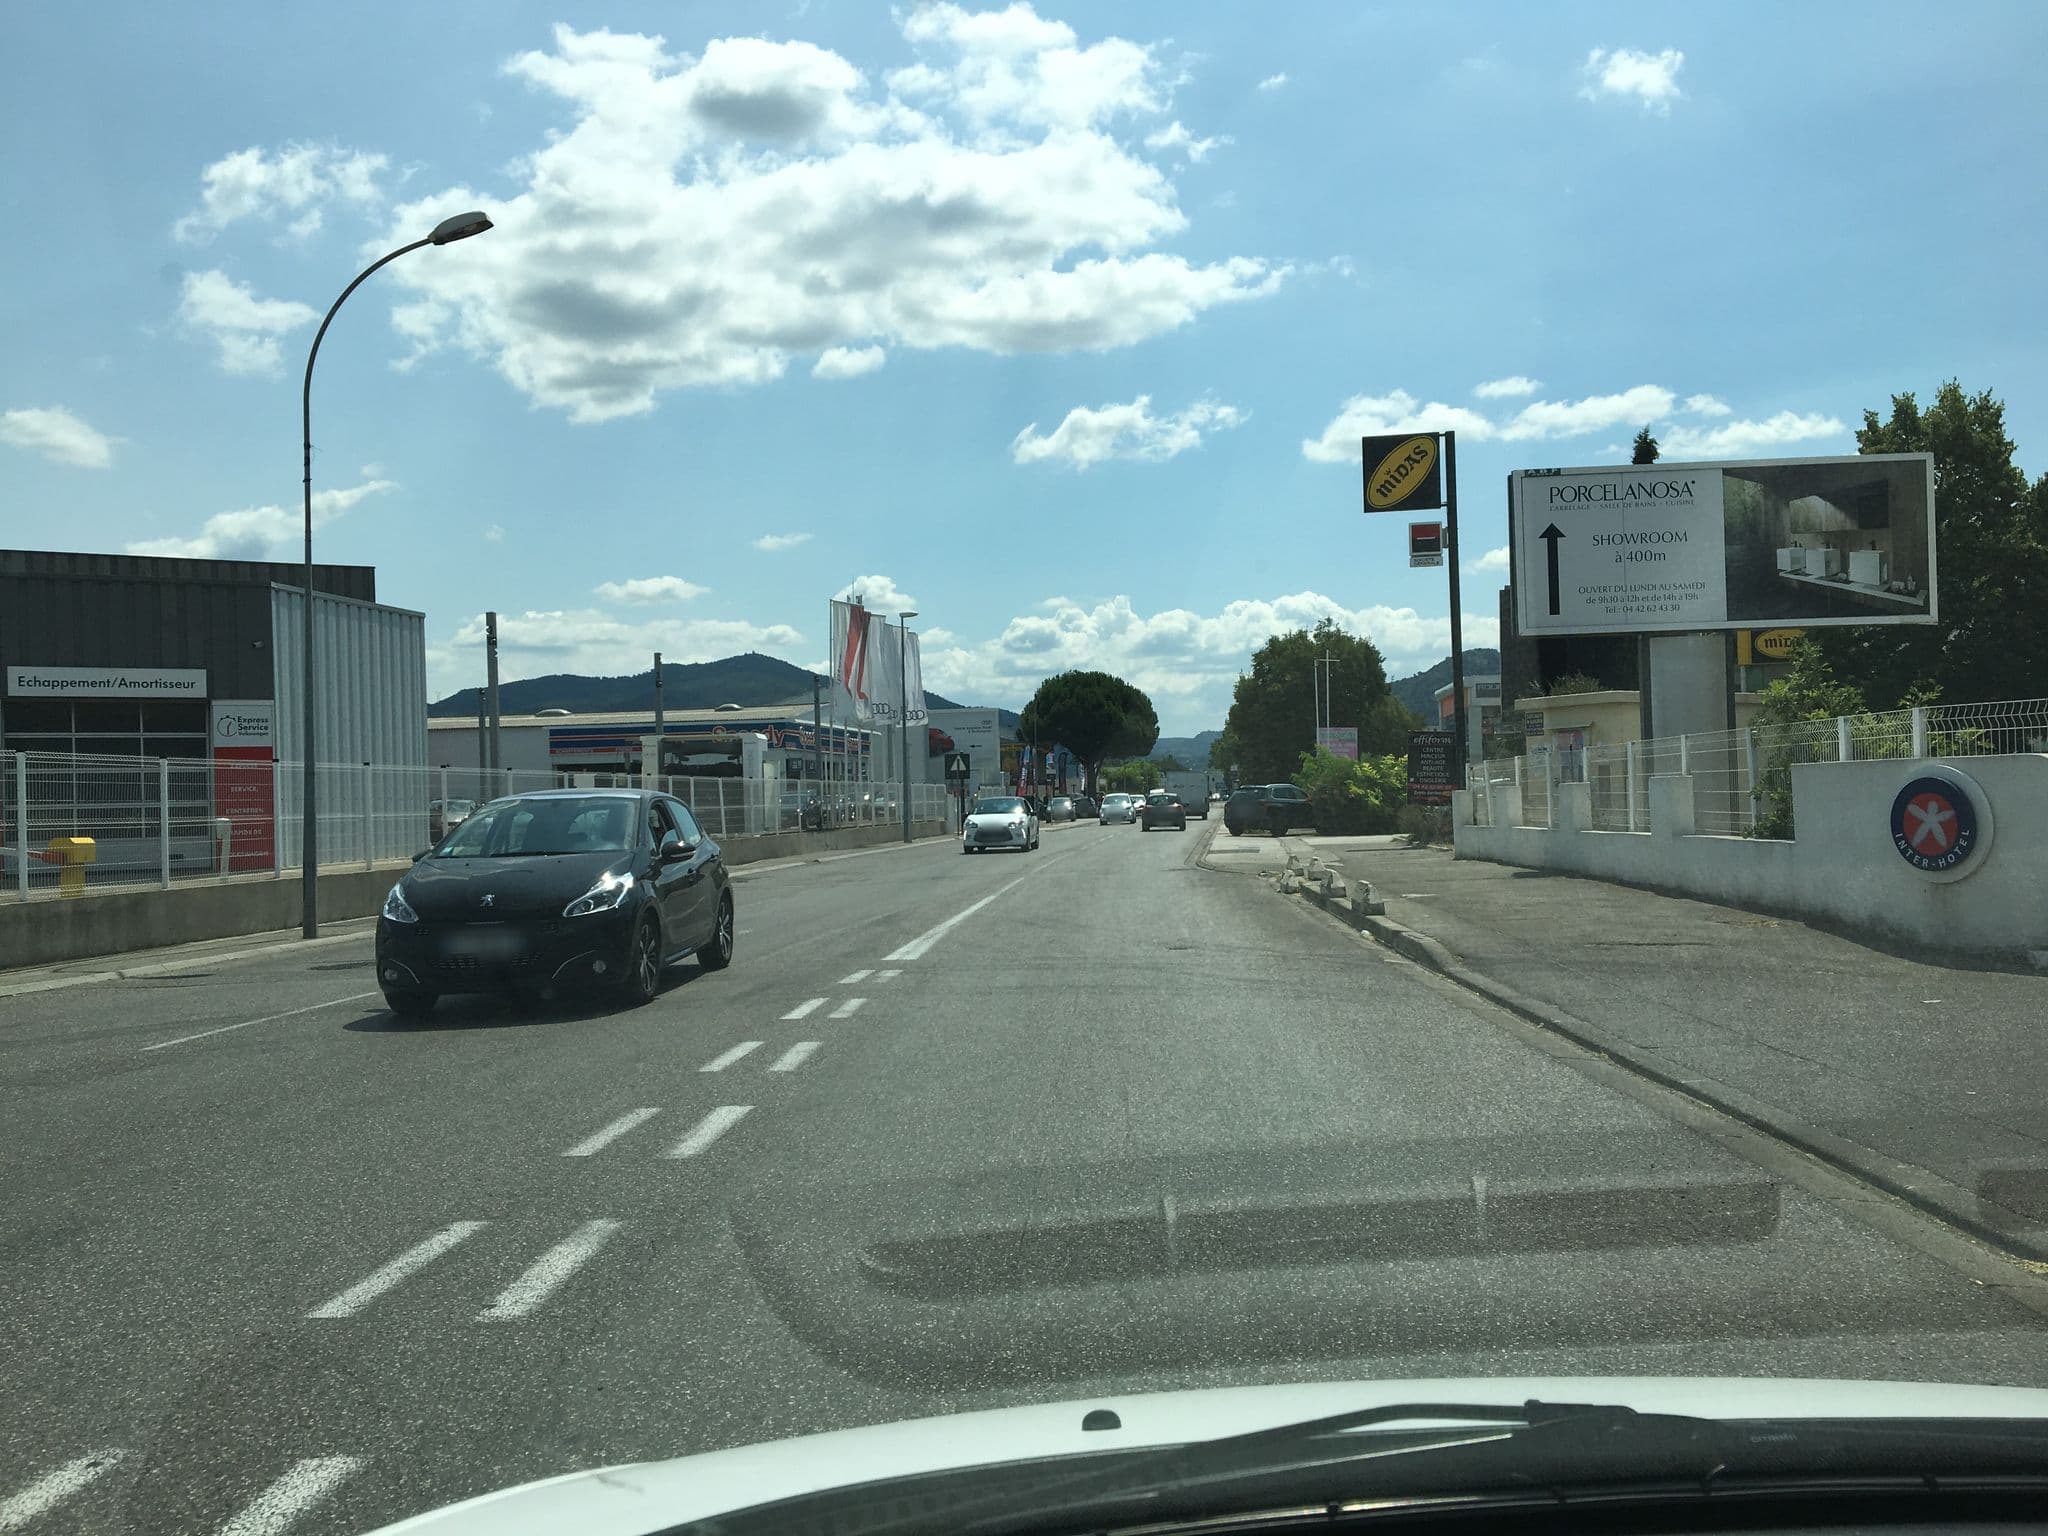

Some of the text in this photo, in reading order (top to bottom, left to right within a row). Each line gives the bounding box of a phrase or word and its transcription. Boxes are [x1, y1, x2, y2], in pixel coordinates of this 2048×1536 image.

[1549, 481, 1693, 503] PORCELANOSA
[1592, 531, 1688, 546] SHOWROOM
[1615, 550, 1666, 563] à 400m
[1578, 582, 1706, 594] OUVERT DU LUNDI AU SAMEDI
[1585, 596, 1597, 605] de
[1598, 595, 1619, 604] 9h30
[1626, 594, 1640, 603] 12h
[1641, 594, 1649, 602] et
[1650, 594, 1662, 602] de
[1663, 593, 1677, 601] 14h
[1685, 592, 1700, 601] 19h
[1622, 605, 1633, 614] 04
[1634, 604, 1646, 613] 42
[17, 675, 196, 690] Echappement/Amortisseur
[237, 716, 269, 725] Express
